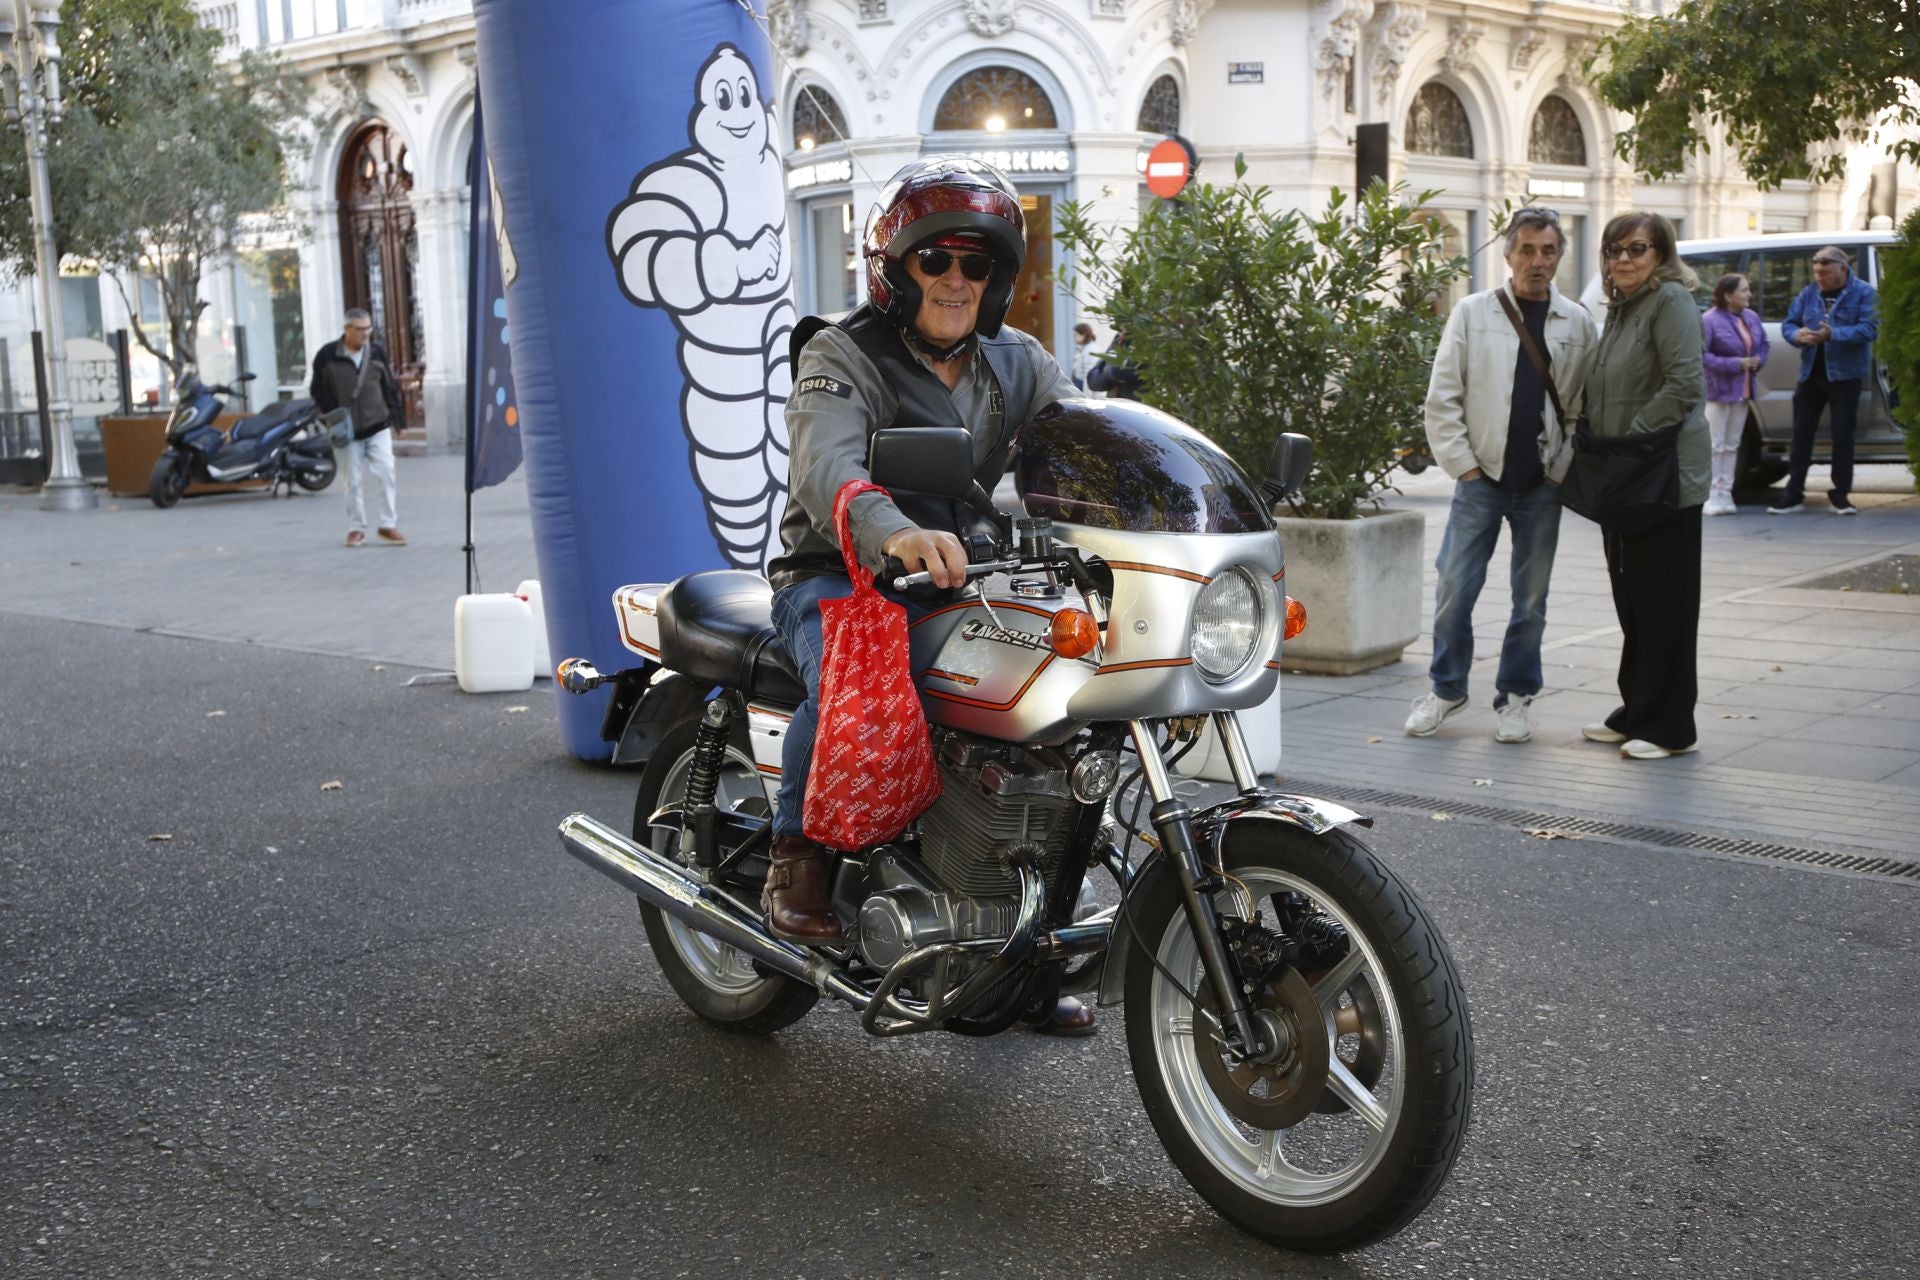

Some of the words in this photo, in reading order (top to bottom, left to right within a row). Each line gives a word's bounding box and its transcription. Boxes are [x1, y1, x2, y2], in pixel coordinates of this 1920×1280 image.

[1013, 150, 1069, 171] KING
[801, 379, 839, 393] 1903
[834, 689, 860, 707] MAPFRE
[833, 712, 848, 727] Club
[833, 715, 857, 736] MAPFRE
[883, 721, 897, 738] Club
[829, 740, 845, 756] Club
[829, 742, 853, 765] MAPFRE
[855, 746, 872, 759] Club
[881, 750, 898, 765] Club
[825, 769, 840, 785] Club
[826, 771, 849, 794] MAPFRE
[850, 772, 869, 787] Club
[879, 777, 894, 792] Club
[845, 801, 863, 815] Club
[871, 804, 889, 818] Club
